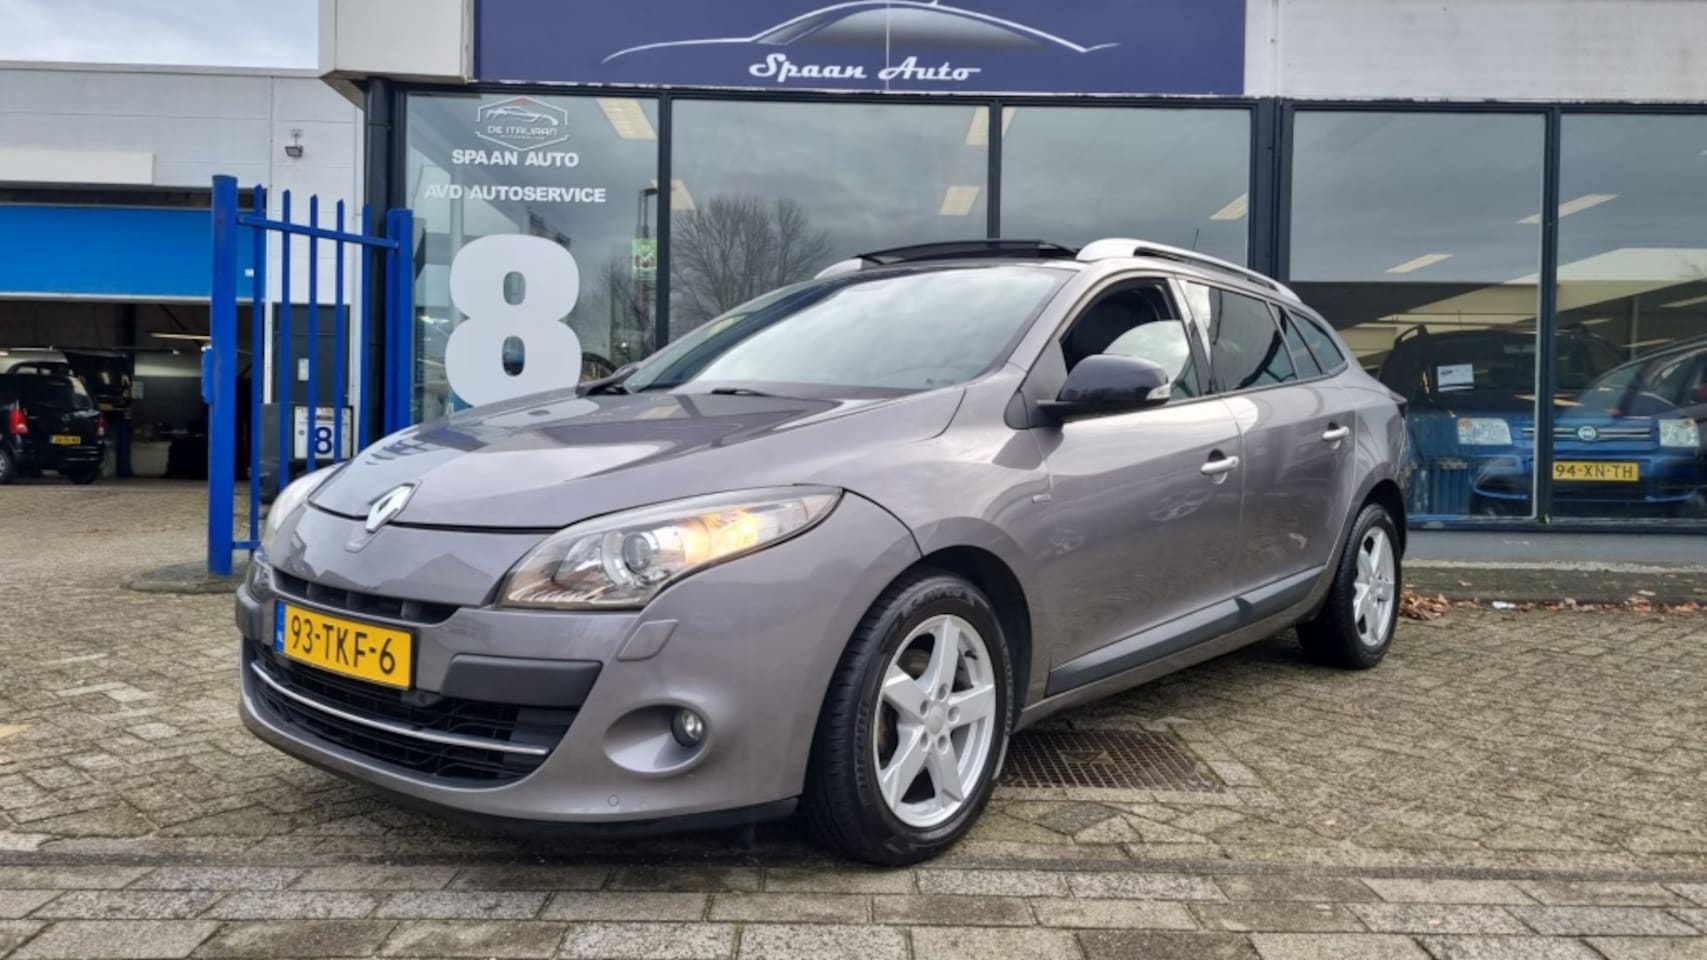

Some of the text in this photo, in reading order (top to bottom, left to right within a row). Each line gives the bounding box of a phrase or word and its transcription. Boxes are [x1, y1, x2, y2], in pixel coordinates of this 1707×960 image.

[749, 53, 981, 82] Spaan Auto
[487, 126, 503, 134] DE
[452, 149, 579, 167] SPAAN AUTO
[425, 185, 606, 203] AVD AUTOSERVICE
[445, 234, 582, 407] 8
[315, 427, 332, 455] 8
[1555, 464, 1633, 478] 94-XN-TH
[291, 615, 395, 674] 93-TKF-6
